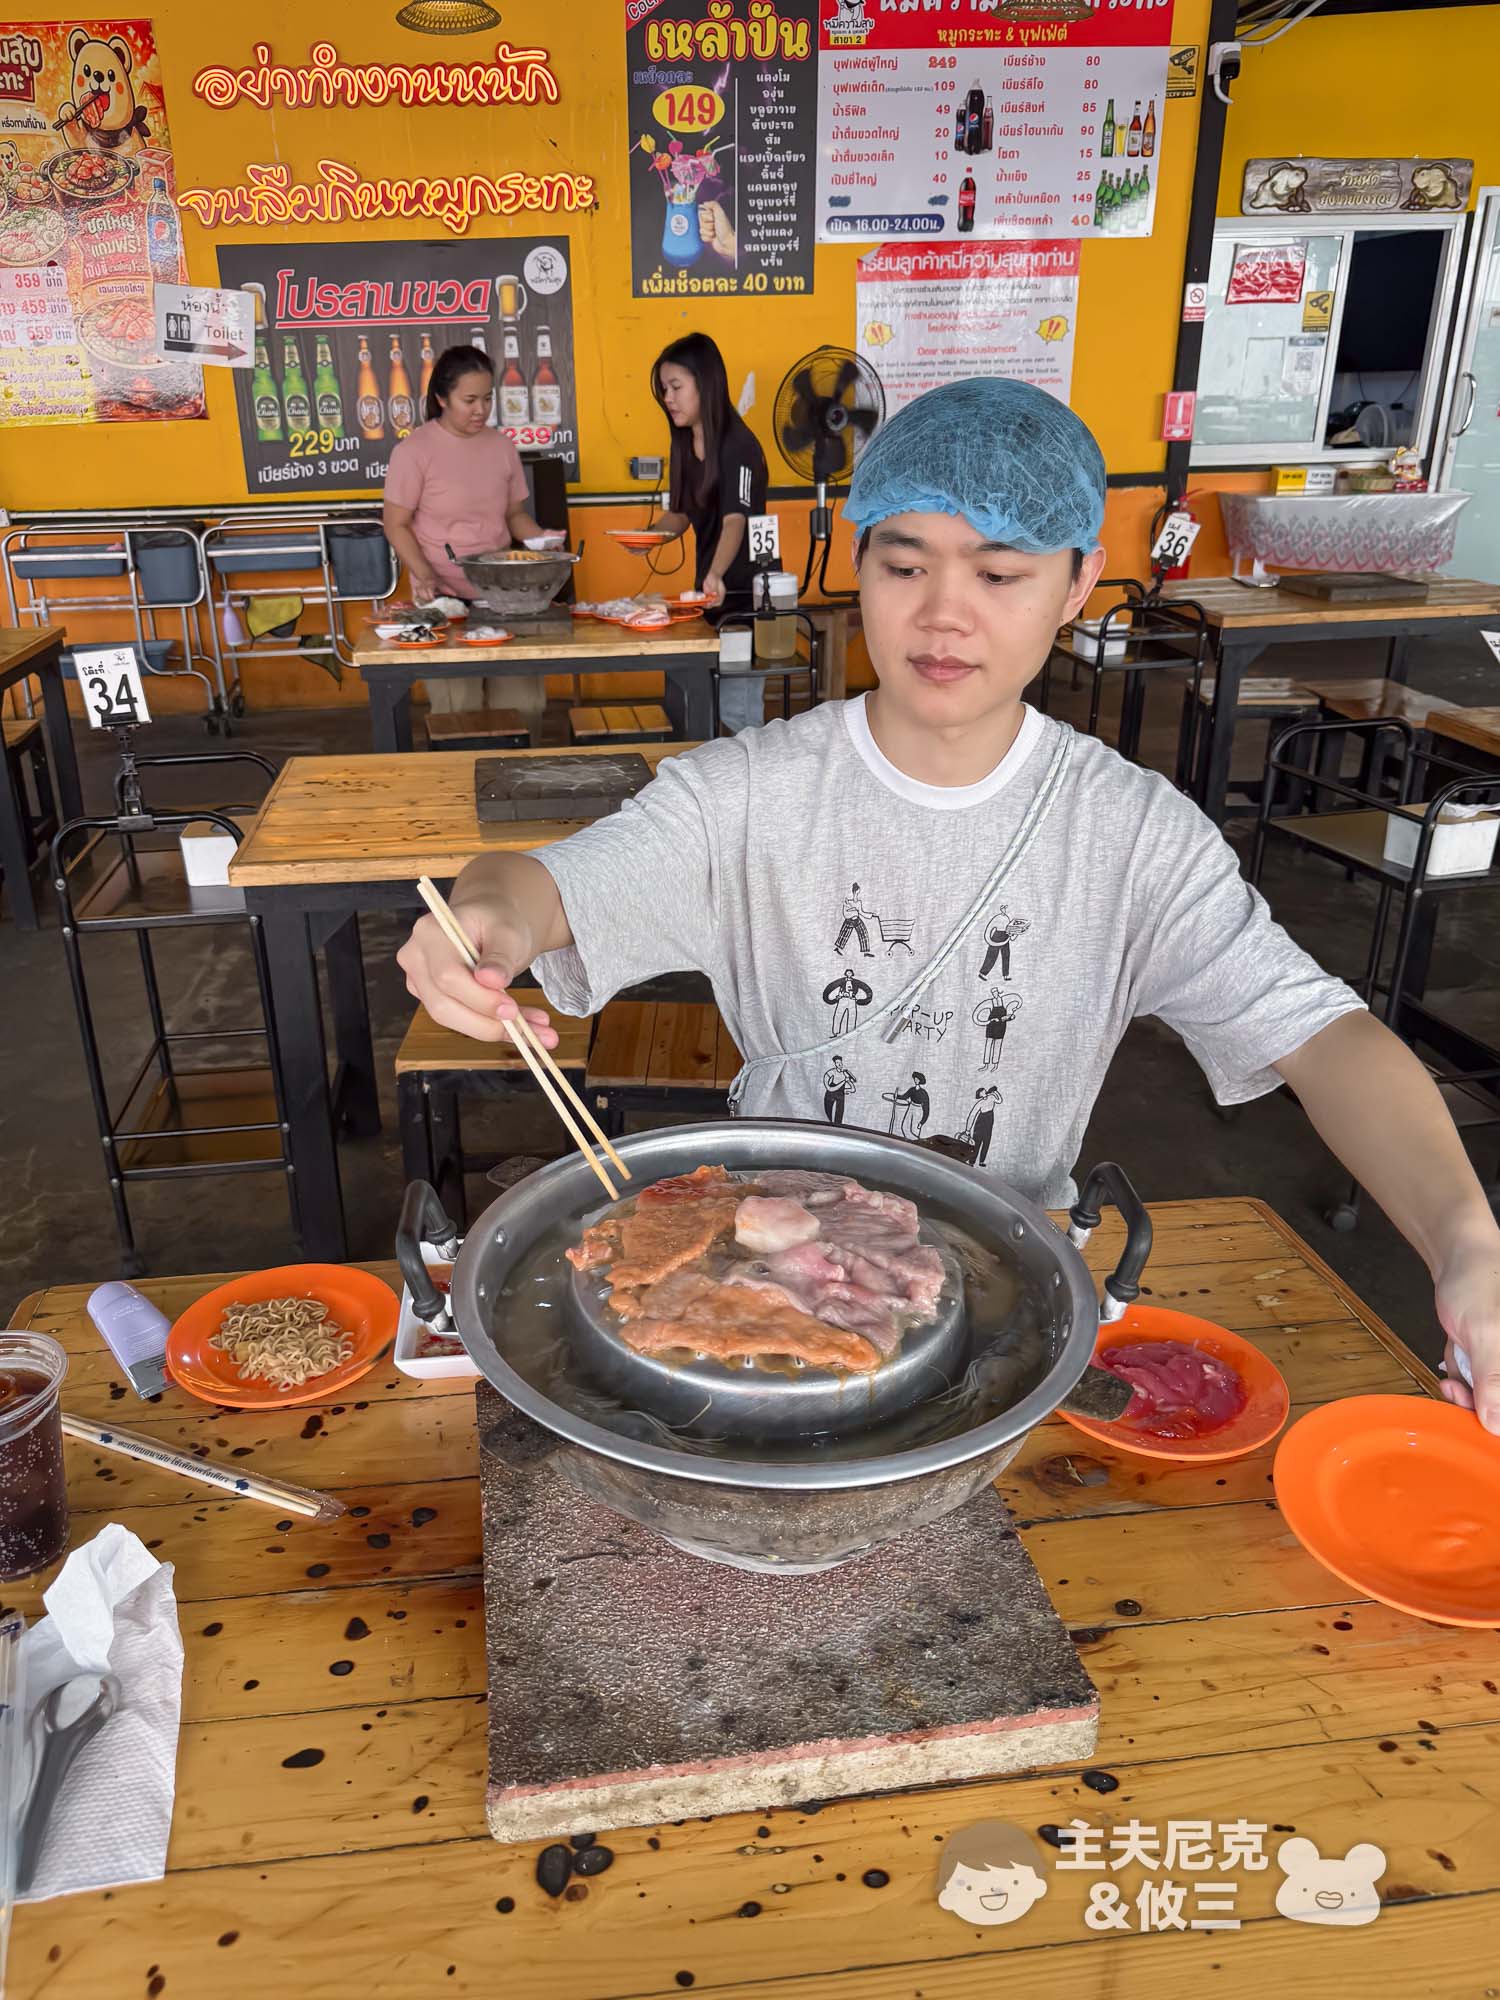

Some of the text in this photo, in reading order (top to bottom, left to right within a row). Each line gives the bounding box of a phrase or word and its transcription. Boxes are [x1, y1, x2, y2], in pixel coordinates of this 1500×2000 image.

[646, 0, 811, 61] เหล้าปัน
[937, 28, 1001, 47] หมูกระทะ
[1005, 29, 1015, 41] &
[833, 36, 862, 44] สาขา 2
[1003, 54, 1100, 66] เบียร์ช้าง 80
[193, 42, 561, 110] อย่าทำงานหนัก
[756, 69, 791, 83] แตงโม
[1002, 77, 1098, 90] เบียร์ลีโอ 80
[934, 81, 956, 91] 109
[762, 87, 785, 103] องุ่น
[665, 93, 716, 126] 149
[936, 104, 951, 114] 49
[1000, 100, 1097, 113] เบียร์สิงห์ 85
[752, 118, 795, 130] สับปะรด
[1080, 126, 1094, 135] 90
[765, 133, 781, 145] ส้ม
[832, 125, 949, 141] น้ำดื่มขวดใหญ่ 20
[739, 147, 806, 164] แอปเปิ้ลเขียว
[831, 149, 948, 163] น้ำดื่มขวดเล็ก 10
[998, 147, 1093, 160] โซดา 15
[761, 164, 785, 180] ลิ้นจี่
[932, 173, 947, 183] 40
[1076, 171, 1091, 181] 25
[747, 182, 798, 195] แคนตาลูป
[178, 160, 597, 234] จนลืมกินหมูกระทะ
[748, 192, 797, 210] บลูเบอร์รี่
[1072, 193, 1093, 203] 149
[830, 219, 851, 232] เปิด
[1071, 214, 1090, 226] 40
[750, 225, 794, 241] องุ่นแดง
[862, 247, 1075, 276] เรยนลูกค้าหมีความสุขทุกท่าน
[15, 273, 63, 288] 359 บาท
[743, 273, 768, 292] 40
[773, 275, 805, 291] บาท
[275, 269, 492, 320] โปรสามขวด
[22, 298, 47, 314] 459
[204, 324, 244, 341] Toilet
[289, 429, 360, 458] 229 บาท
[258, 458, 359, 484] เบียร์ช้าง 3 ขวด
[753, 530, 775, 553] 35
[1160, 531, 1188, 557] 36
[89, 673, 138, 715] 34
[890, 1003, 954, 1027] P-UP
[902, 1019, 947, 1043] ARTY
